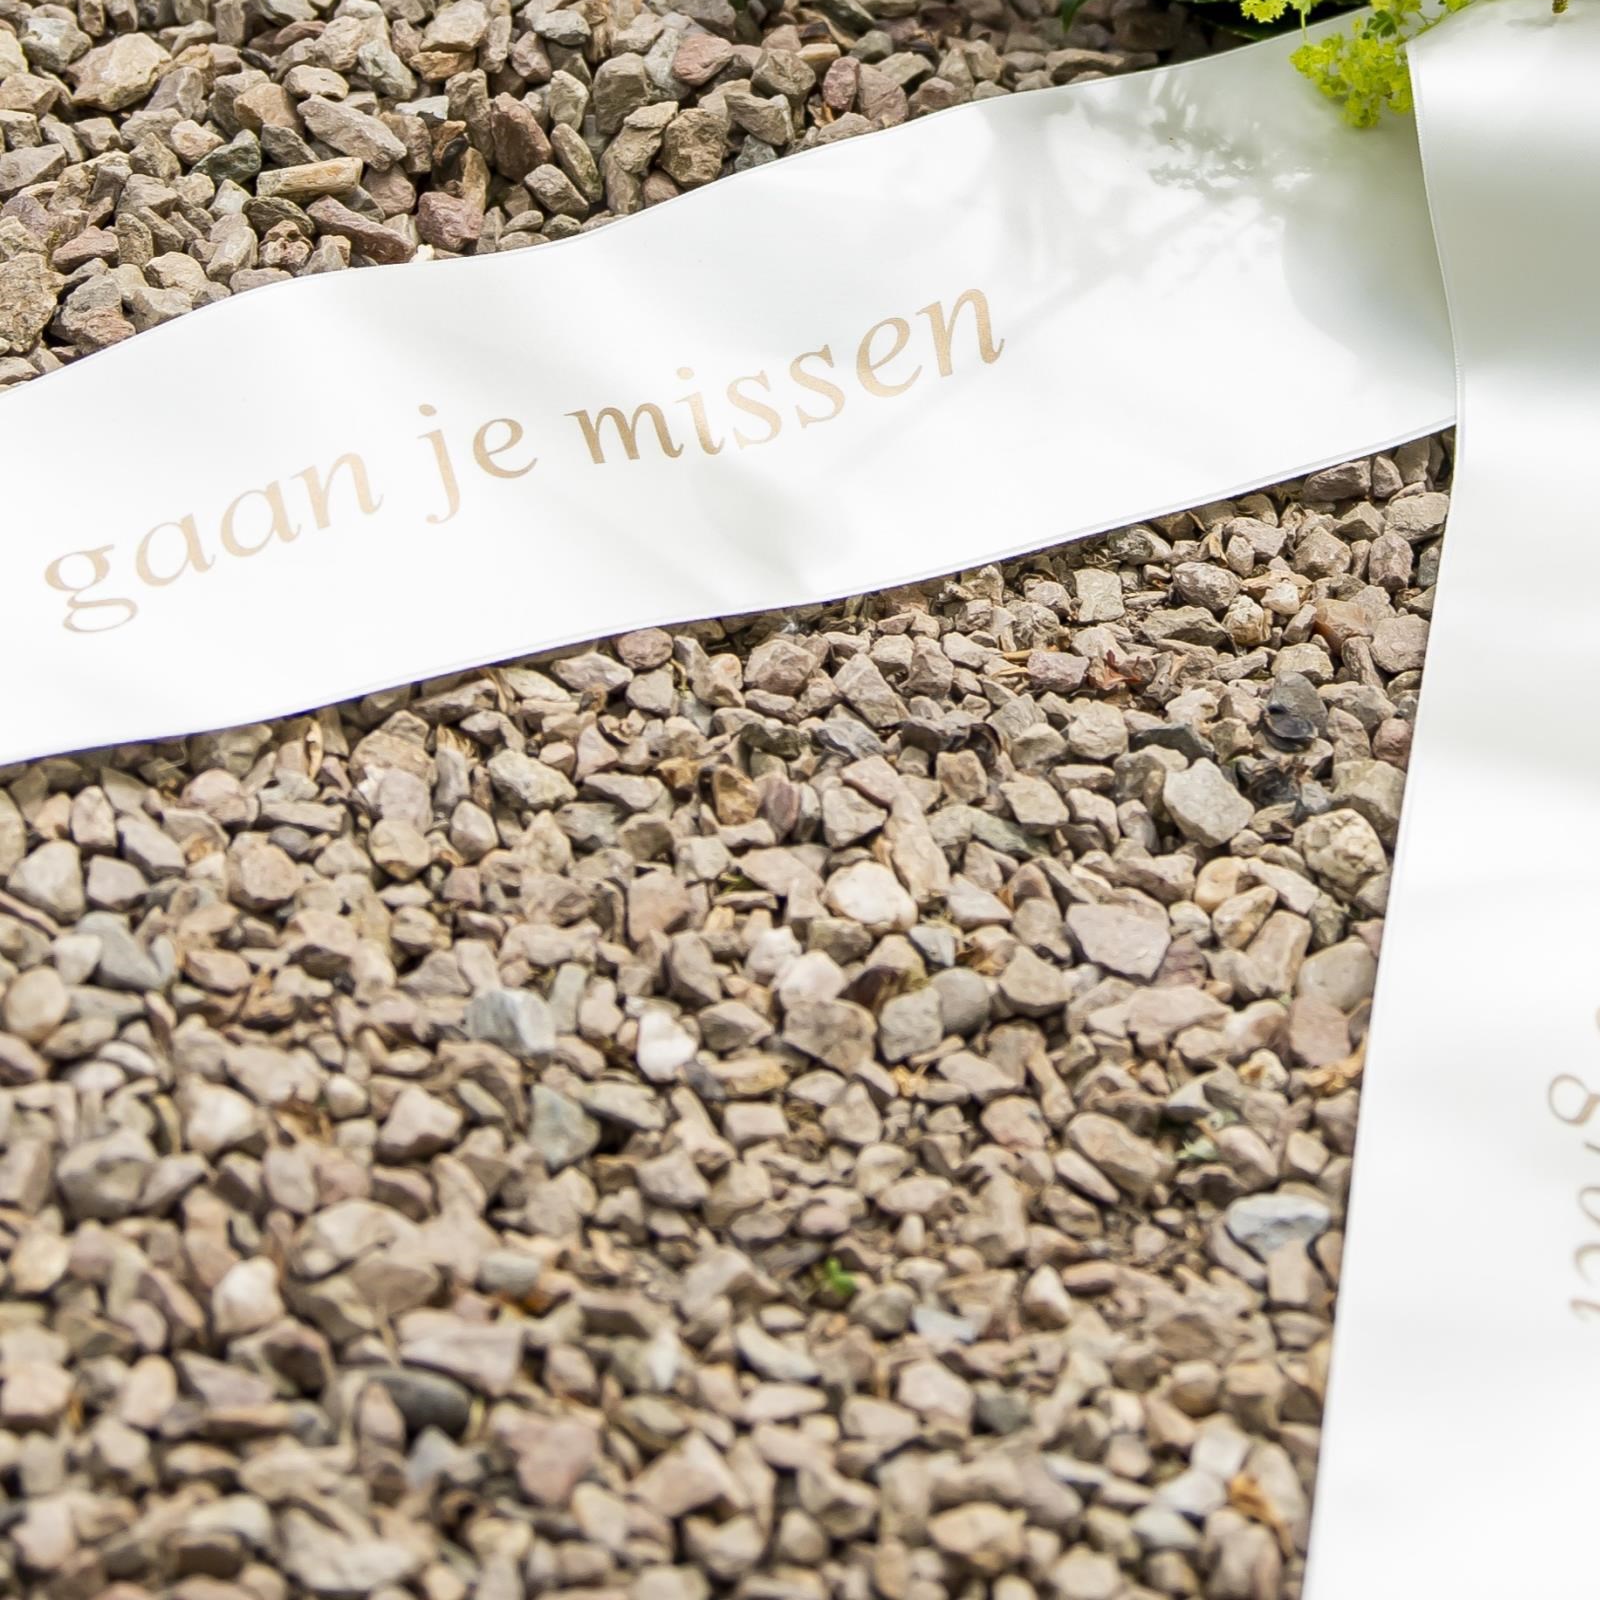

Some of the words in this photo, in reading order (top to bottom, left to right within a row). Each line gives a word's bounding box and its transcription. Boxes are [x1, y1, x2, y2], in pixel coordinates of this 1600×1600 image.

[44, 453, 382, 633] gaan
[418, 403, 539, 525] je
[564, 288, 1005, 464] missen
